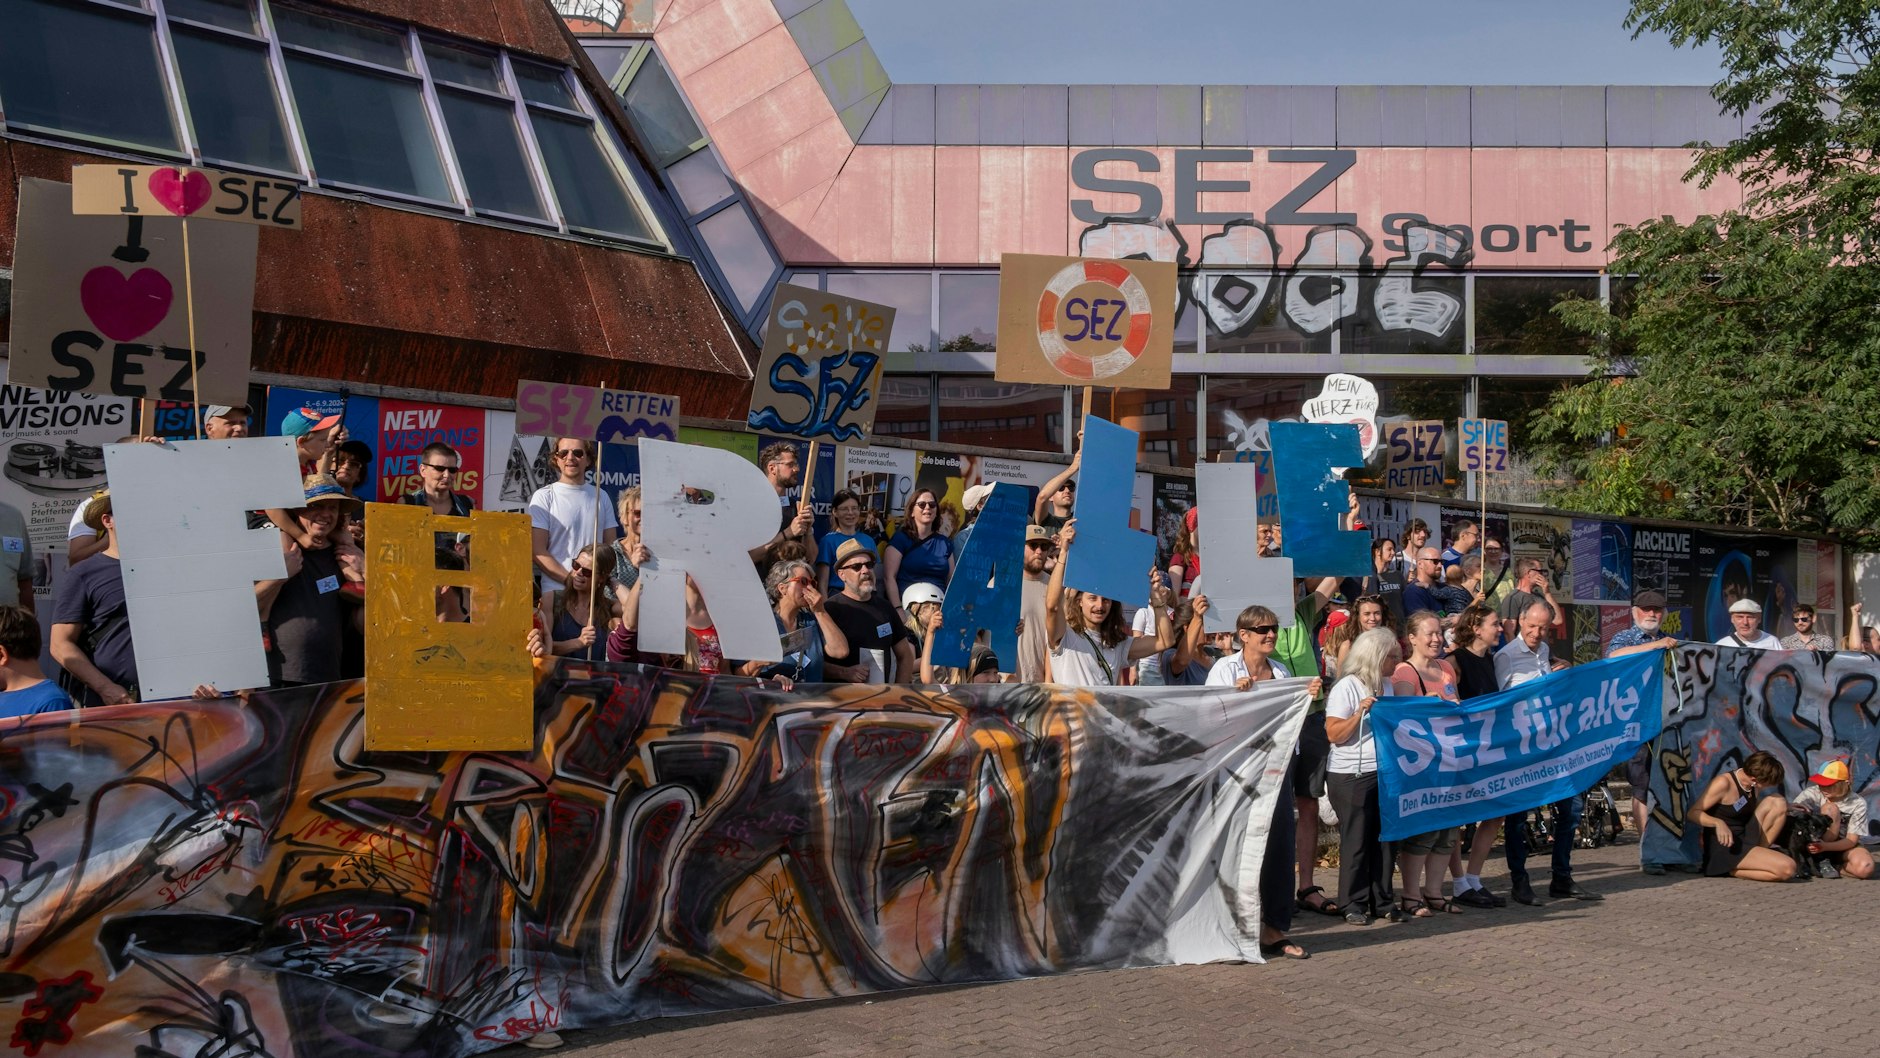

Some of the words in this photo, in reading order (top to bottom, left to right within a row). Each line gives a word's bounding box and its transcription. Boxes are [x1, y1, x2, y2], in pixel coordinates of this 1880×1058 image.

[117, 168, 139, 213] I
[214, 176, 301, 226] SEZ
[1070, 149, 1358, 225] SEZ
[1064, 297, 1127, 341] SEZ
[47, 330, 206, 400] SEZ
[1328, 377, 1361, 395] MEIN
[0, 403, 126, 430] VISIONS
[384, 409, 442, 431] NEW
[517, 383, 597, 438] SEZ
[601, 391, 674, 417] RETTEN
[1311, 399, 1354, 418] HERZ
[53, 428, 79, 436] sound
[384, 427, 479, 452] VISIONS
[1389, 424, 1443, 463] SEZ
[1462, 420, 1505, 447] SAVE
[383, 455, 423, 476] NE
[848, 448, 877, 458] Kostenlos
[878, 451, 890, 459] und
[848, 456, 866, 465] sicher
[867, 458, 898, 468] verkaufen.
[918, 455, 934, 465] Safe
[934, 456, 946, 466] bei
[984, 461, 1010, 470] Kostenlos
[1465, 446, 1507, 471] SEZ
[382, 470, 478, 497] VISNS
[984, 469, 1000, 478] sicher
[1001, 470, 1028, 479] verkaufen.
[1388, 460, 1444, 488] RETTEN
[31, 507, 76, 517] Pfefferber
[31, 516, 55, 525] Berlin
[1634, 530, 1691, 552] ARCHIVE
[1393, 709, 1507, 777] SEZ
[1511, 695, 1574, 755] für
[1402, 798, 1419, 812] Den
[1420, 791, 1462, 807] Abriss
[1465, 787, 1486, 800] des
[1487, 778, 1507, 794] SEZ
[1585, 743, 1614, 762] braucht
